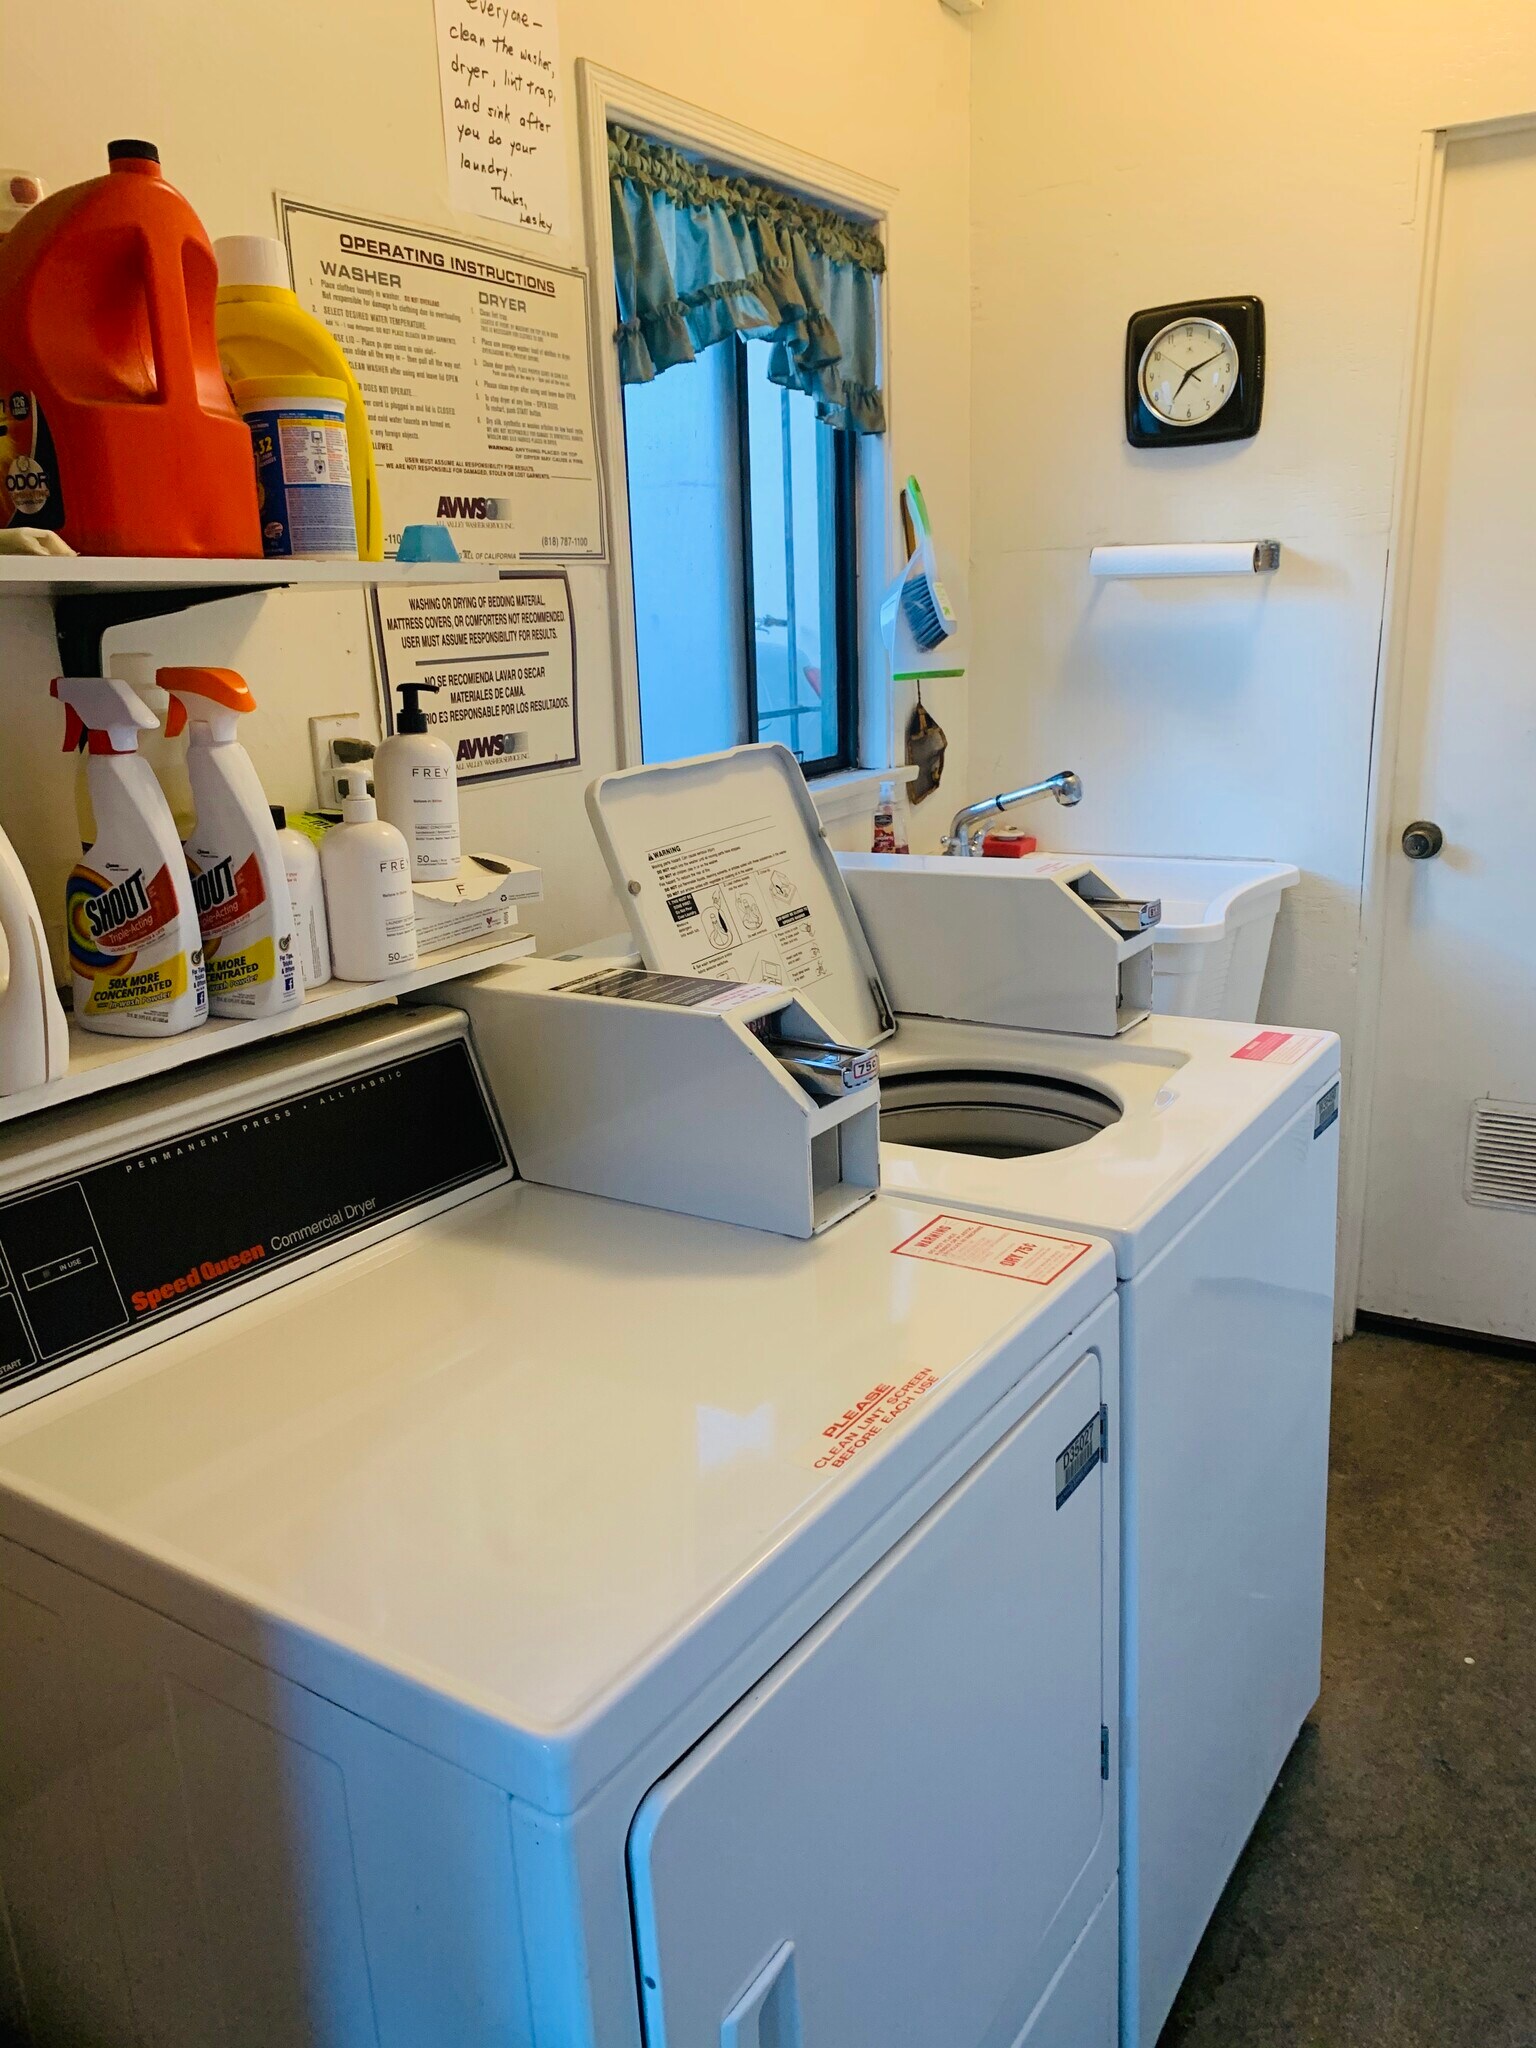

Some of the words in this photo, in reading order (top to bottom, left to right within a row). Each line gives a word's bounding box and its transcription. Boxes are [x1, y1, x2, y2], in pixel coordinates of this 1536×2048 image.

[449, 22, 485, 47] clean
[492, 36, 514, 56] the
[520, 49, 554, 79] washer,
[451, 53, 495, 87] dryer,
[504, 69, 522, 91] lint
[527, 81, 556, 107] trap,
[454, 94, 480, 113] and
[488, 104, 510, 123] sink
[520, 111, 551, 133] after
[457, 124, 480, 143] you
[488, 129, 502, 145] do
[510, 141, 537, 157] your
[460, 152, 513, 181] laundry.
[491, 186, 528, 210] Thanks,
[519, 211, 553, 235] Lesley
[340, 233, 445, 268] OPERATING
[450, 257, 556, 294] INSTRUCTIONS
[320, 260, 402, 288] WASHER
[372, 300, 391, 311] damage
[399, 305, 418, 316] clothing
[479, 291, 527, 313] DRYER
[323, 305, 343, 317] SELECT
[345, 309, 368, 321] DESIRED
[370, 314, 389, 325] WATER
[1168, 335, 1174, 344] 11
[1185, 327, 1193, 337] 12
[1154, 351, 1161, 361] 10
[1221, 343, 1226, 351] 2
[366, 363, 388, 374] WASHER
[389, 366, 401, 375] after
[1150, 373, 1154, 381] 9
[1226, 363, 1230, 373] 3
[363, 383, 378, 393] DOES
[379, 385, 389, 394] NOT
[1154, 392, 1159, 401] 8
[1220, 384, 1225, 393] 4
[390, 402, 408, 411] plugged
[1167, 405, 1172, 414] 7
[1186, 409, 1191, 418] 6
[1206, 401, 1211, 411] 5
[417, 465, 451, 474] RESPONSIBLE
[489, 470, 506, 478] STOLEN
[420, 458, 433, 466] MUST
[434, 459, 454, 467] ASSUME
[464, 461, 503, 470] RESPONSIBILITY
[436, 496, 487, 520] AVWS
[542, 536, 559, 548] (818)
[560, 536, 588, 546] 787-1100
[475, 552, 484, 560] OF
[484, 552, 517, 560] CALIFORNIA
[409, 597, 440, 611] WASHING
[441, 597, 452, 610] OR
[453, 596, 477, 609] DRYING
[478, 596, 487, 608] OF
[488, 595, 516, 608] BEDDING
[387, 617, 424, 631] MATTRESS
[424, 615, 454, 630] COVERS,
[454, 615, 464, 628] OR
[465, 613, 507, 627] COMFORTERS
[508, 612, 520, 625] NOT
[521, 610, 566, 624] RECOMMENDED.
[401, 635, 421, 649] USER
[421, 635, 440, 648] MUST
[441, 633, 468, 647] ASSUME
[469, 630, 518, 645] RESPONSIBILITY
[518, 629, 531, 642] FOR
[532, 628, 558, 641] RESULTS.
[437, 674, 447, 688] SE
[448, 670, 494, 688] RECOMIENDA
[495, 669, 517, 683] LAVAR
[517, 668, 523, 680] O
[524, 666, 546, 680] SECAR
[450, 688, 494, 704] MATERIALES
[494, 687, 504, 699] DE
[505, 685, 526, 698] CAMA.
[439, 710, 449, 724] ES
[449, 705, 500, 722] RESPONSABLE
[501, 703, 515, 716] POR
[516, 701, 529, 714] LOS
[530, 696, 570, 713] RESULTADOS.
[456, 734, 505, 762] AVWS
[412, 768, 450, 778] FREY
[417, 855, 430, 863] 50
[654, 845, 681, 859] WARNING
[380, 860, 404, 872] FRE
[191, 856, 236, 915] OUT
[85, 868, 150, 937] SHOUT
[109, 915, 154, 943] Triple-Acting
[217, 956, 246, 970] MORE
[388, 952, 401, 962] 50
[108, 976, 128, 989] 50X
[129, 971, 160, 986] MORE
[230, 974, 259, 989] Powder
[94, 978, 173, 1001] CONCENTRATED
[142, 990, 172, 1006] Powder
[125, 1130, 230, 1173] PERMANENT
[242, 1109, 291, 1132] PRESS
[320, 1091, 344, 1105] ALL
[351, 1070, 403, 1094] FABRIC
[913, 1224, 952, 1248] WARNING
[131, 1267, 201, 1312] Speed
[200, 1243, 266, 1281] Queen
[270, 1210, 343, 1252] Commercial
[344, 1197, 377, 1220] Dryer
[1000, 1250, 1021, 1267] DRY
[1018, 1242, 1038, 1257] 75¢
[59, 1262, 68, 1272] IN
[68, 1257, 82, 1269] USE
[814, 1432, 858, 1469] CLEAN
[857, 1407, 885, 1430] LINT
[887, 1368, 932, 1405] SCREEN
[822, 1383, 891, 1438] PLEASE
[831, 1425, 882, 1468] BEFORE
[881, 1396, 915, 1424] EACH
[914, 1375, 939, 1395] USE
